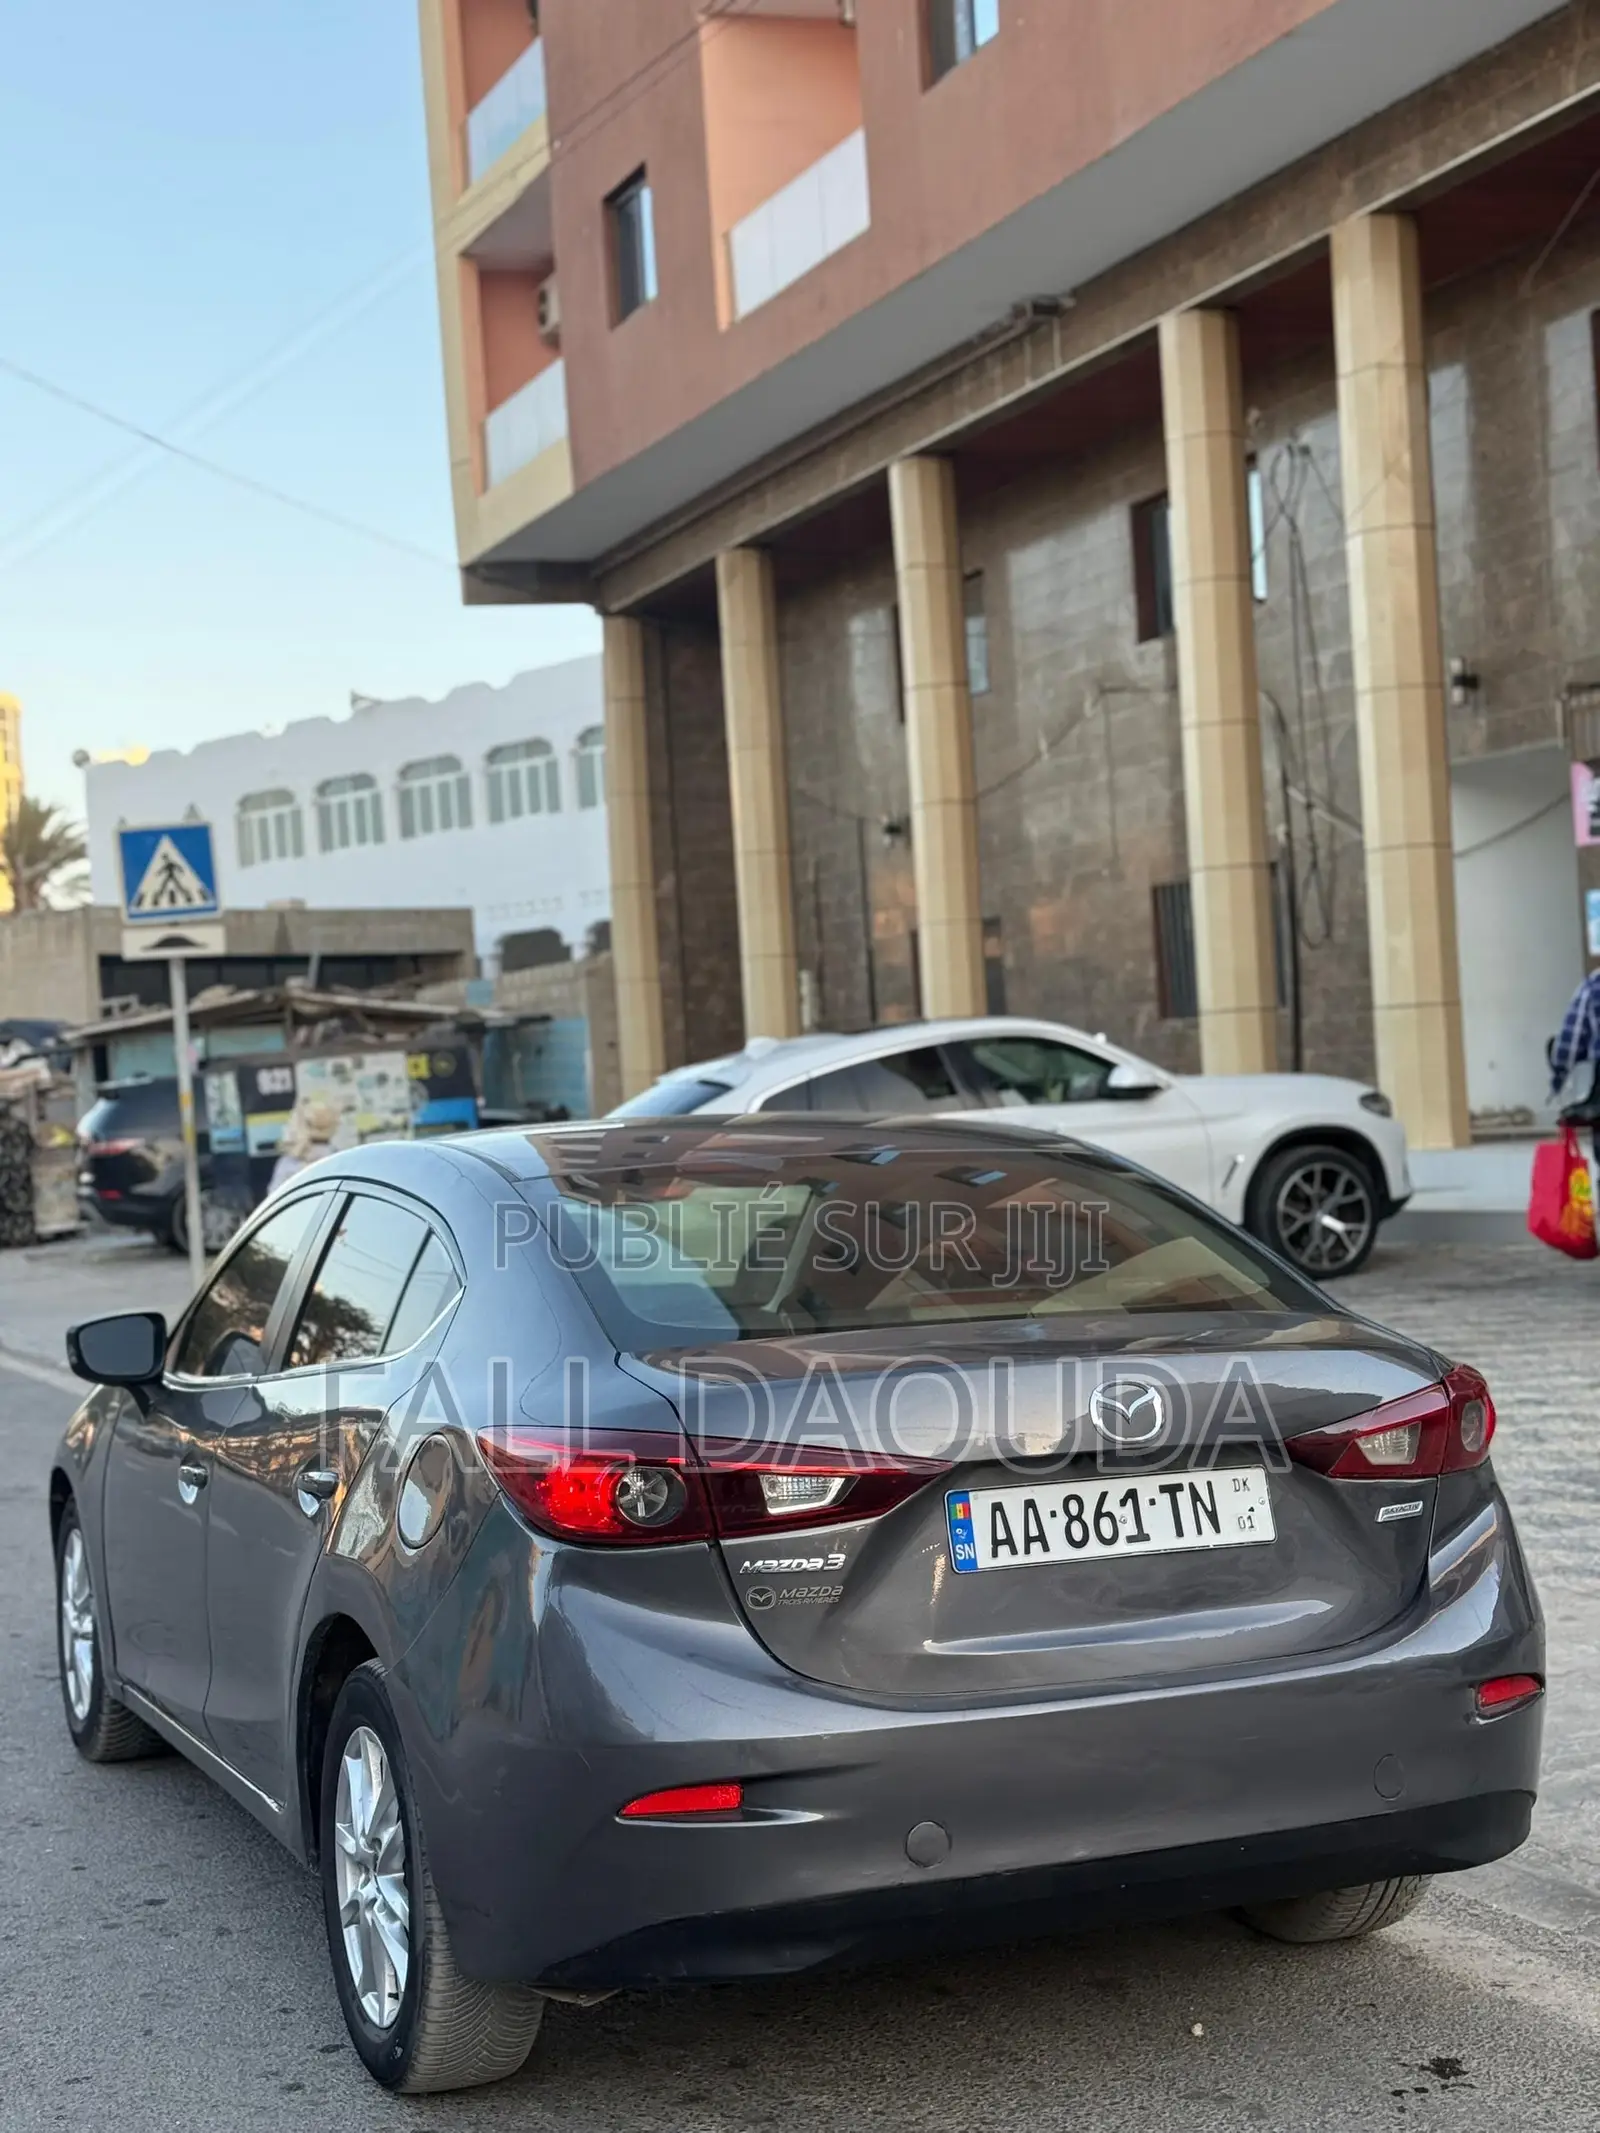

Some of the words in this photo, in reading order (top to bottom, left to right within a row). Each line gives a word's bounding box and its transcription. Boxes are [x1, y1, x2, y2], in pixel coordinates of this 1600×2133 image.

[1232, 1478, 1250, 1492] DK
[1237, 1515, 1255, 1530] 01
[955, 1543, 975, 1560] SN
